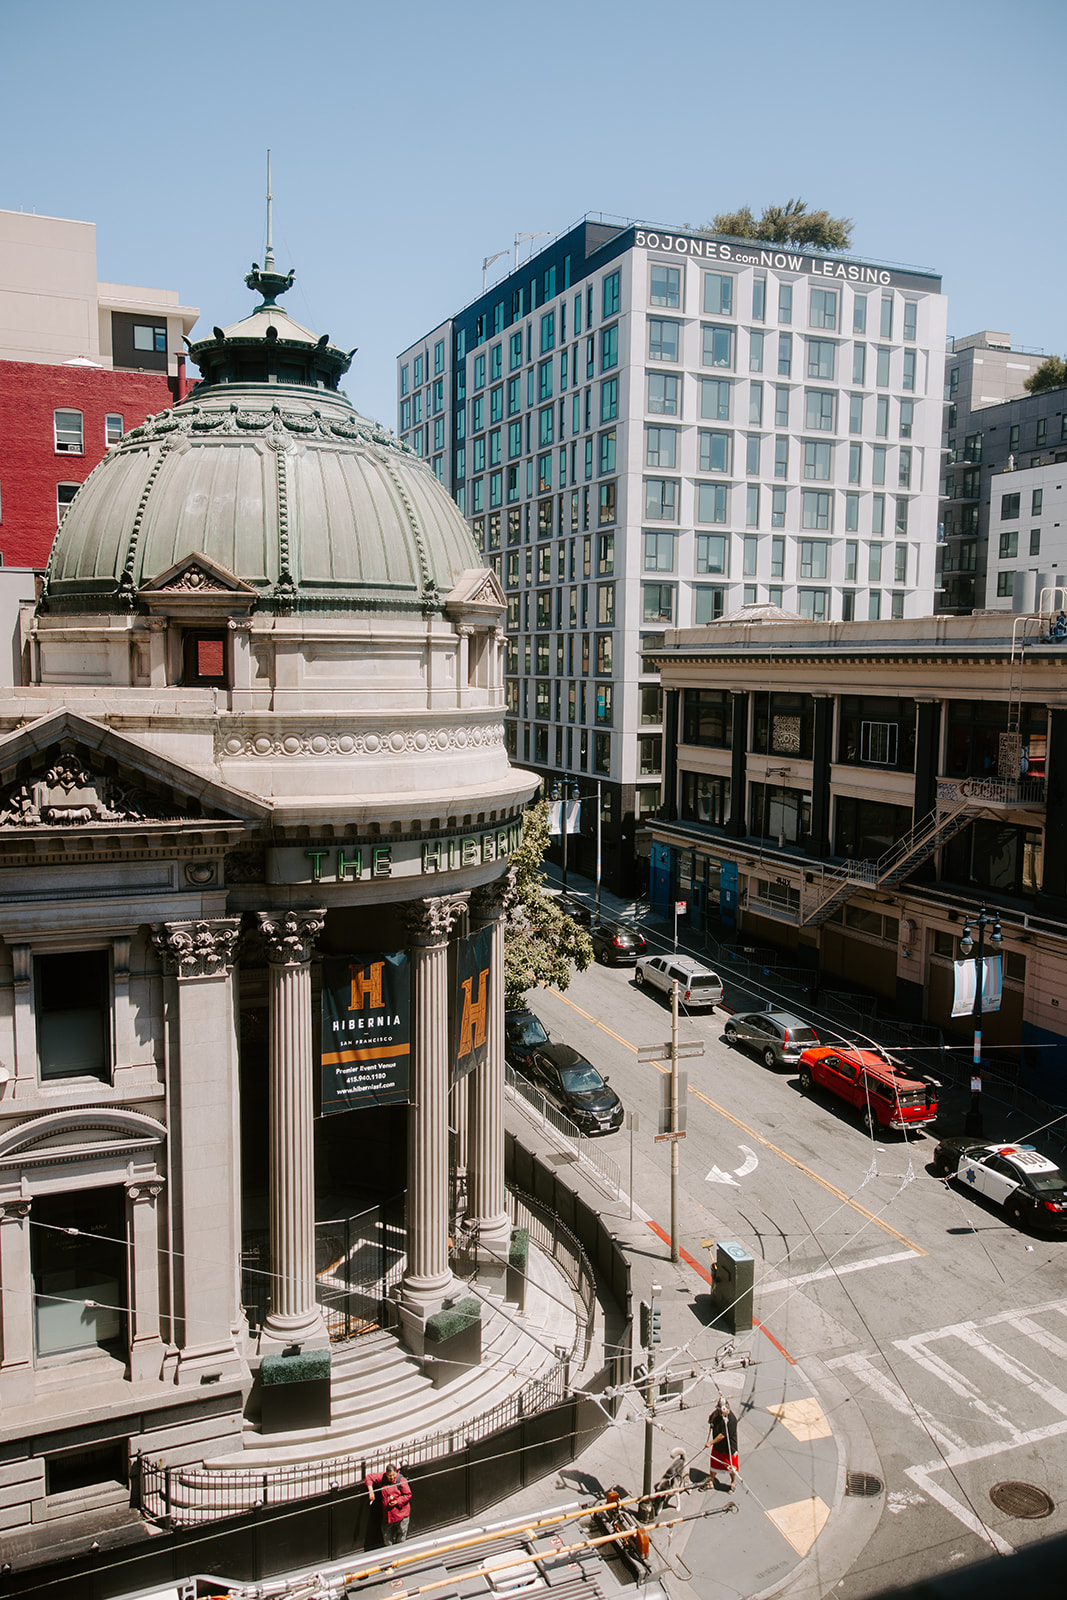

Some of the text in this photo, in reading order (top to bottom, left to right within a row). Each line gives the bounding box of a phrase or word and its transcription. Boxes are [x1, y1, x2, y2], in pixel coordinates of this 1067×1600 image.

[760, 251, 802, 271] NOW
[811, 260, 891, 285] LEASING
[307, 848, 392, 881] THE
[348, 962, 386, 1010] H
[332, 1015, 400, 1032] HIBERNIA
[458, 968, 490, 1060] H
[356, 1036, 392, 1045] FRANCISCO
[336, 1066, 358, 1074] Premier
[1012, 1152, 1047, 1166] 160
